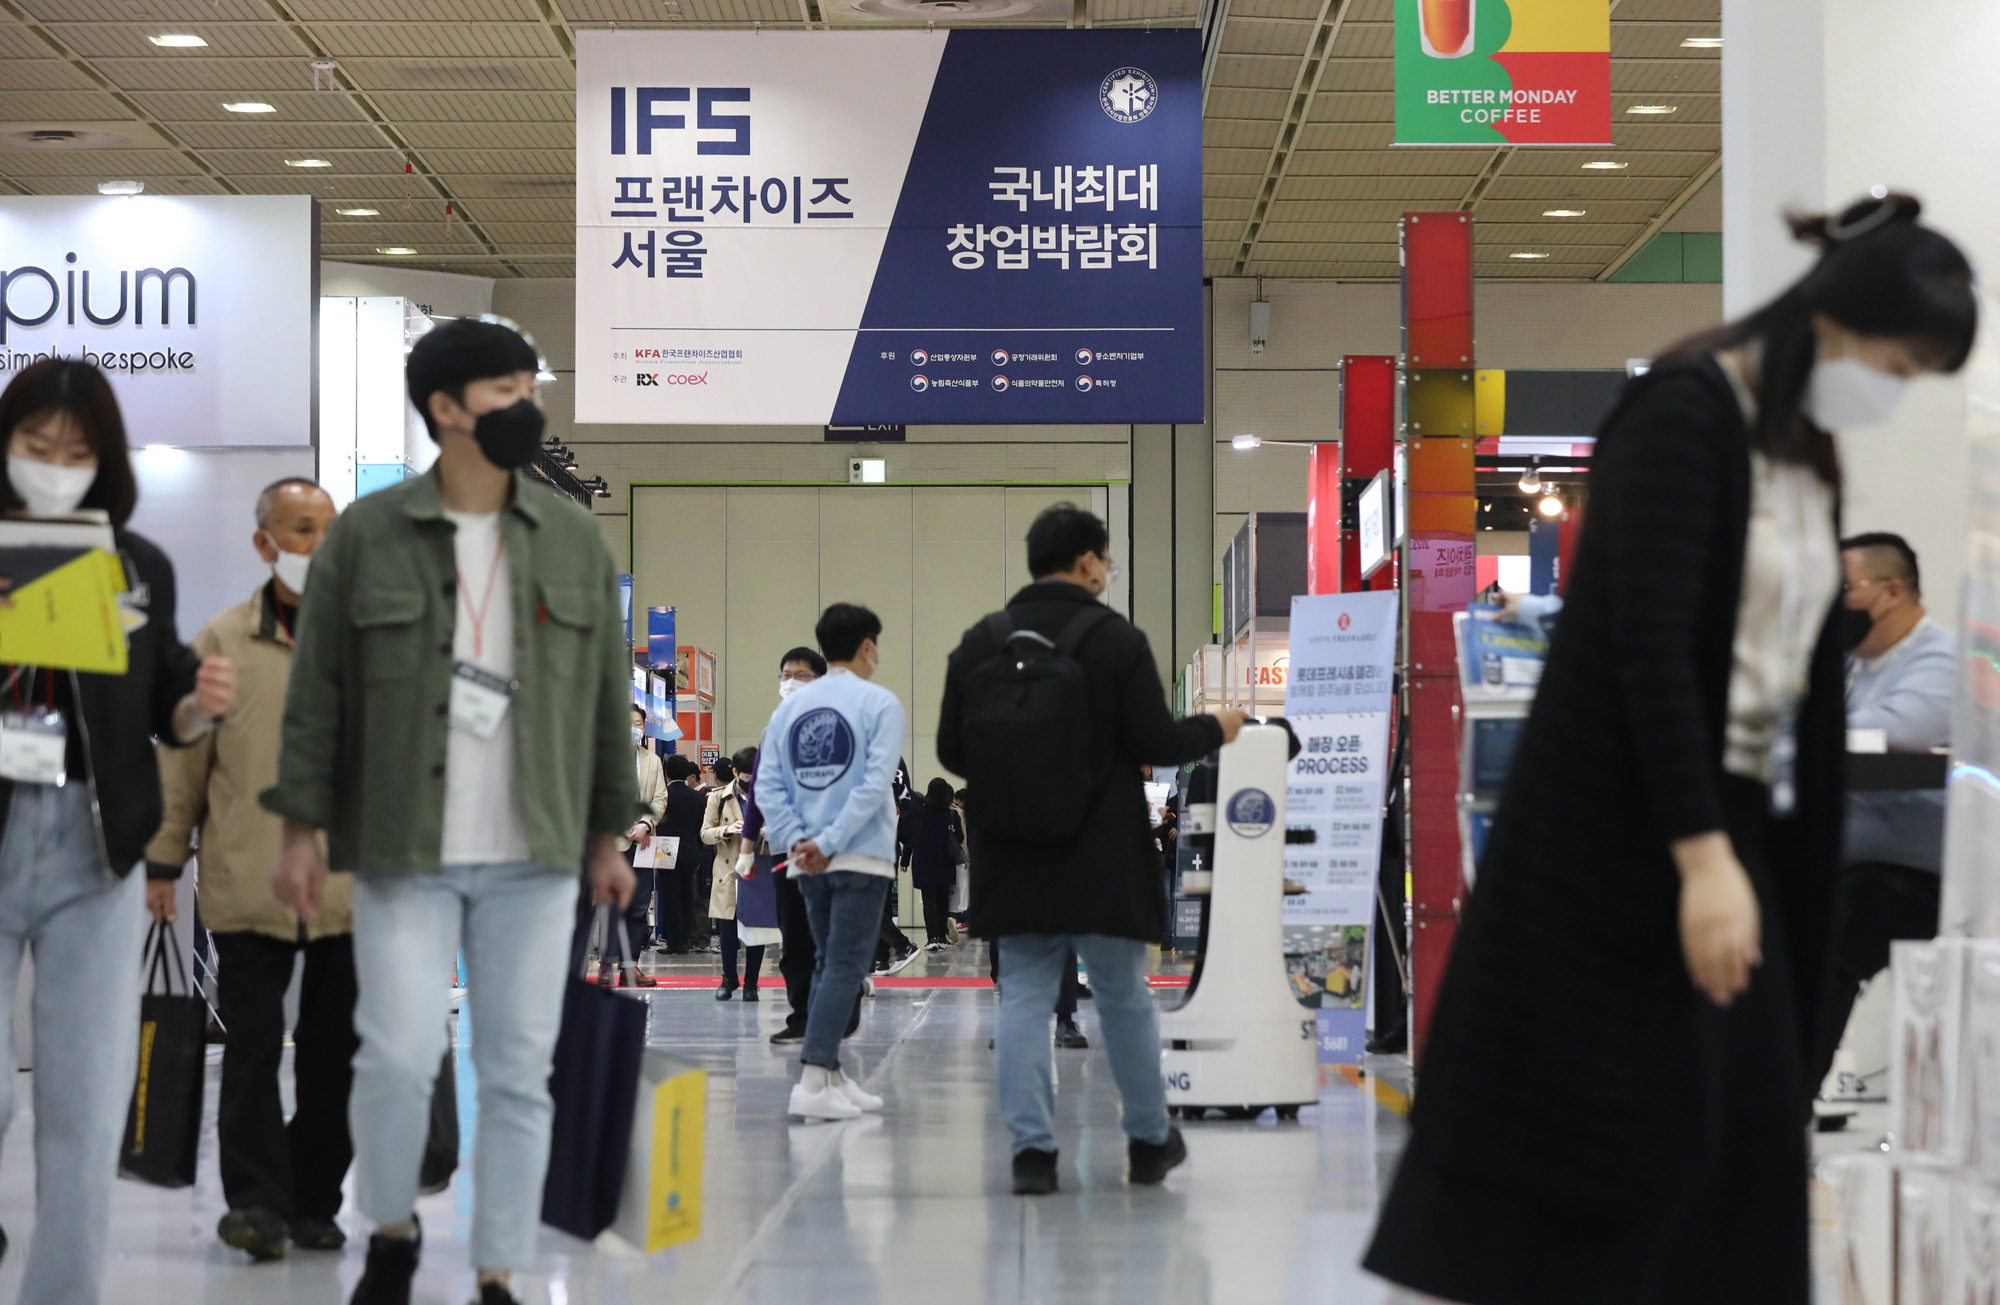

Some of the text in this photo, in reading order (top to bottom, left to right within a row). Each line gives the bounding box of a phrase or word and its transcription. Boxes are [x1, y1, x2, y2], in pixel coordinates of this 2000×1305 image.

[1427, 90, 1578, 104] BETTER MONDAY
[610, 86, 751, 156] IFS
[1460, 109, 1541, 123] COFFEE
[989, 164, 1159, 212] 국내최대
[611, 175, 854, 223] 프랜차이즈
[612, 229, 708, 279] 서울
[947, 223, 1159, 271] 창업박람회
[612, 352, 627, 360] 주최
[635, 349, 743, 359] KFA 한국프랜차이즈산업협회
[880, 351, 896, 360] 후원
[612, 375, 627, 384] 주관
[667, 371, 708, 385] coex
[1095, 379, 1117, 387] 특허청
[1336, 735, 1360, 752] 오픈
[1296, 756, 1368, 774] PROCESS
